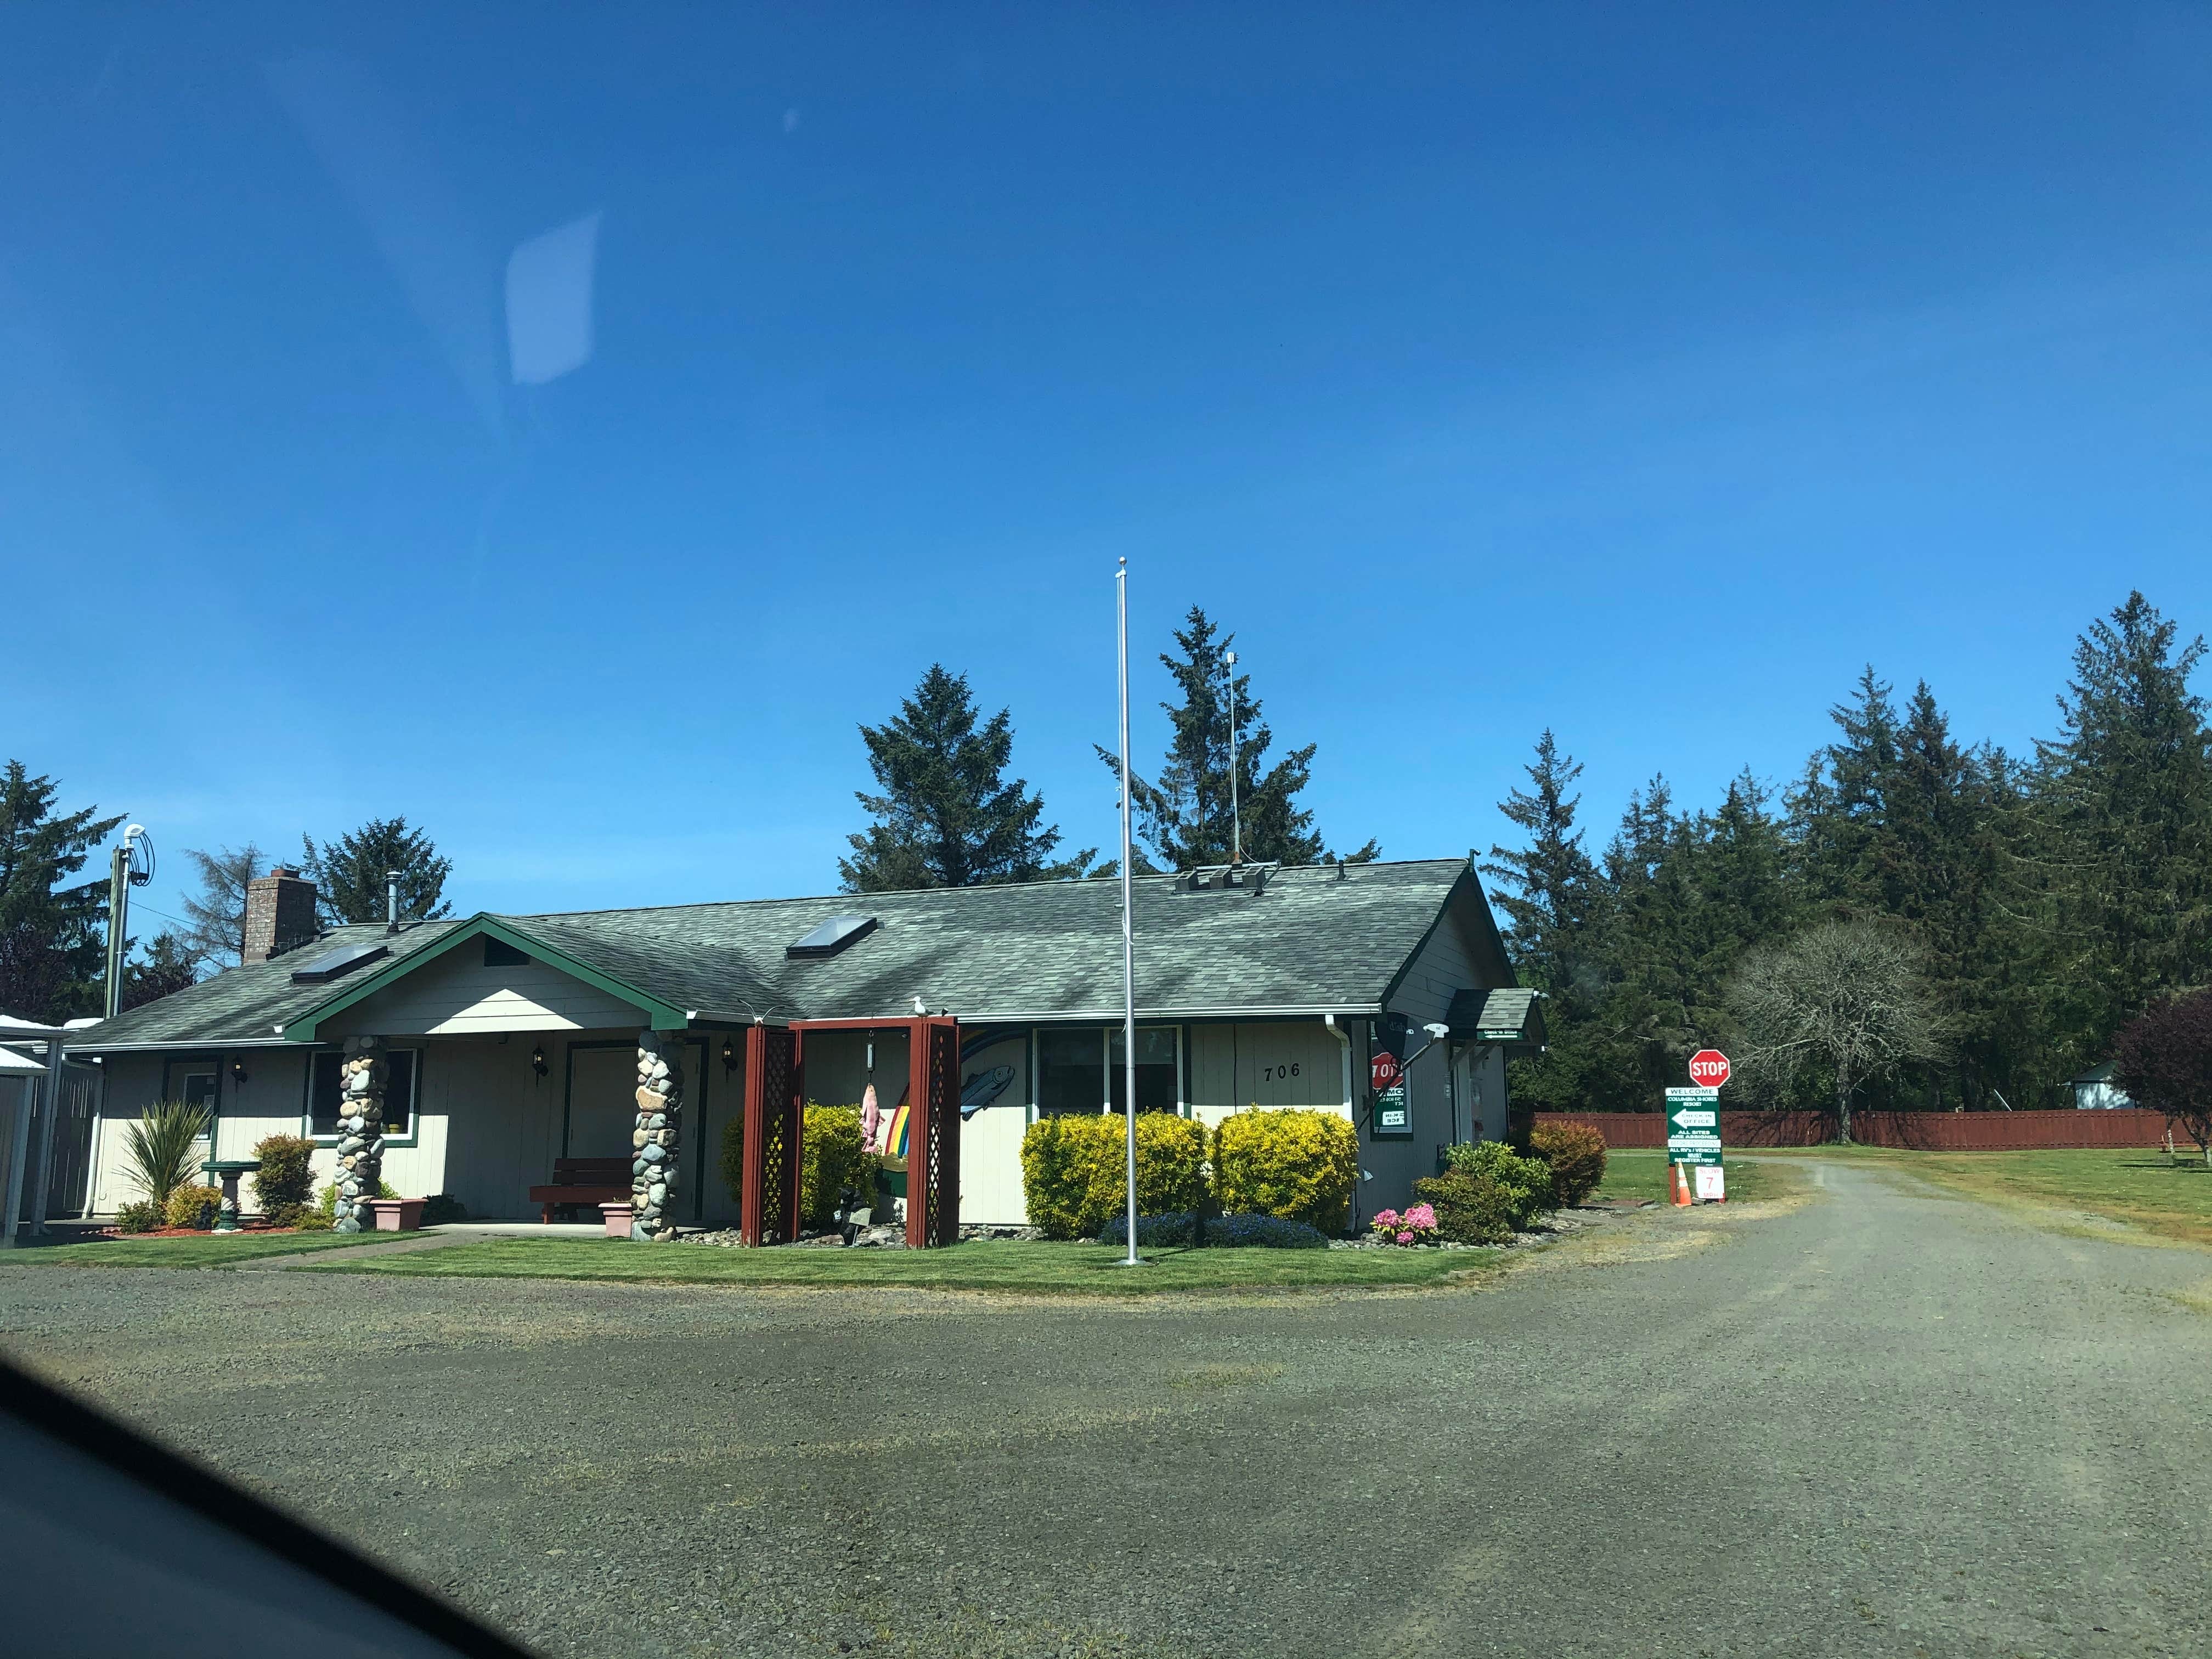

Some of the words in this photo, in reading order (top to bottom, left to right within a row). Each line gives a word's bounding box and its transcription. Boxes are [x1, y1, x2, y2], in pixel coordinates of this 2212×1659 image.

[1265, 1063, 1300, 1082] 706
[1693, 1062, 1726, 1076] STOP
[1706, 1177, 1713, 1189] 7
